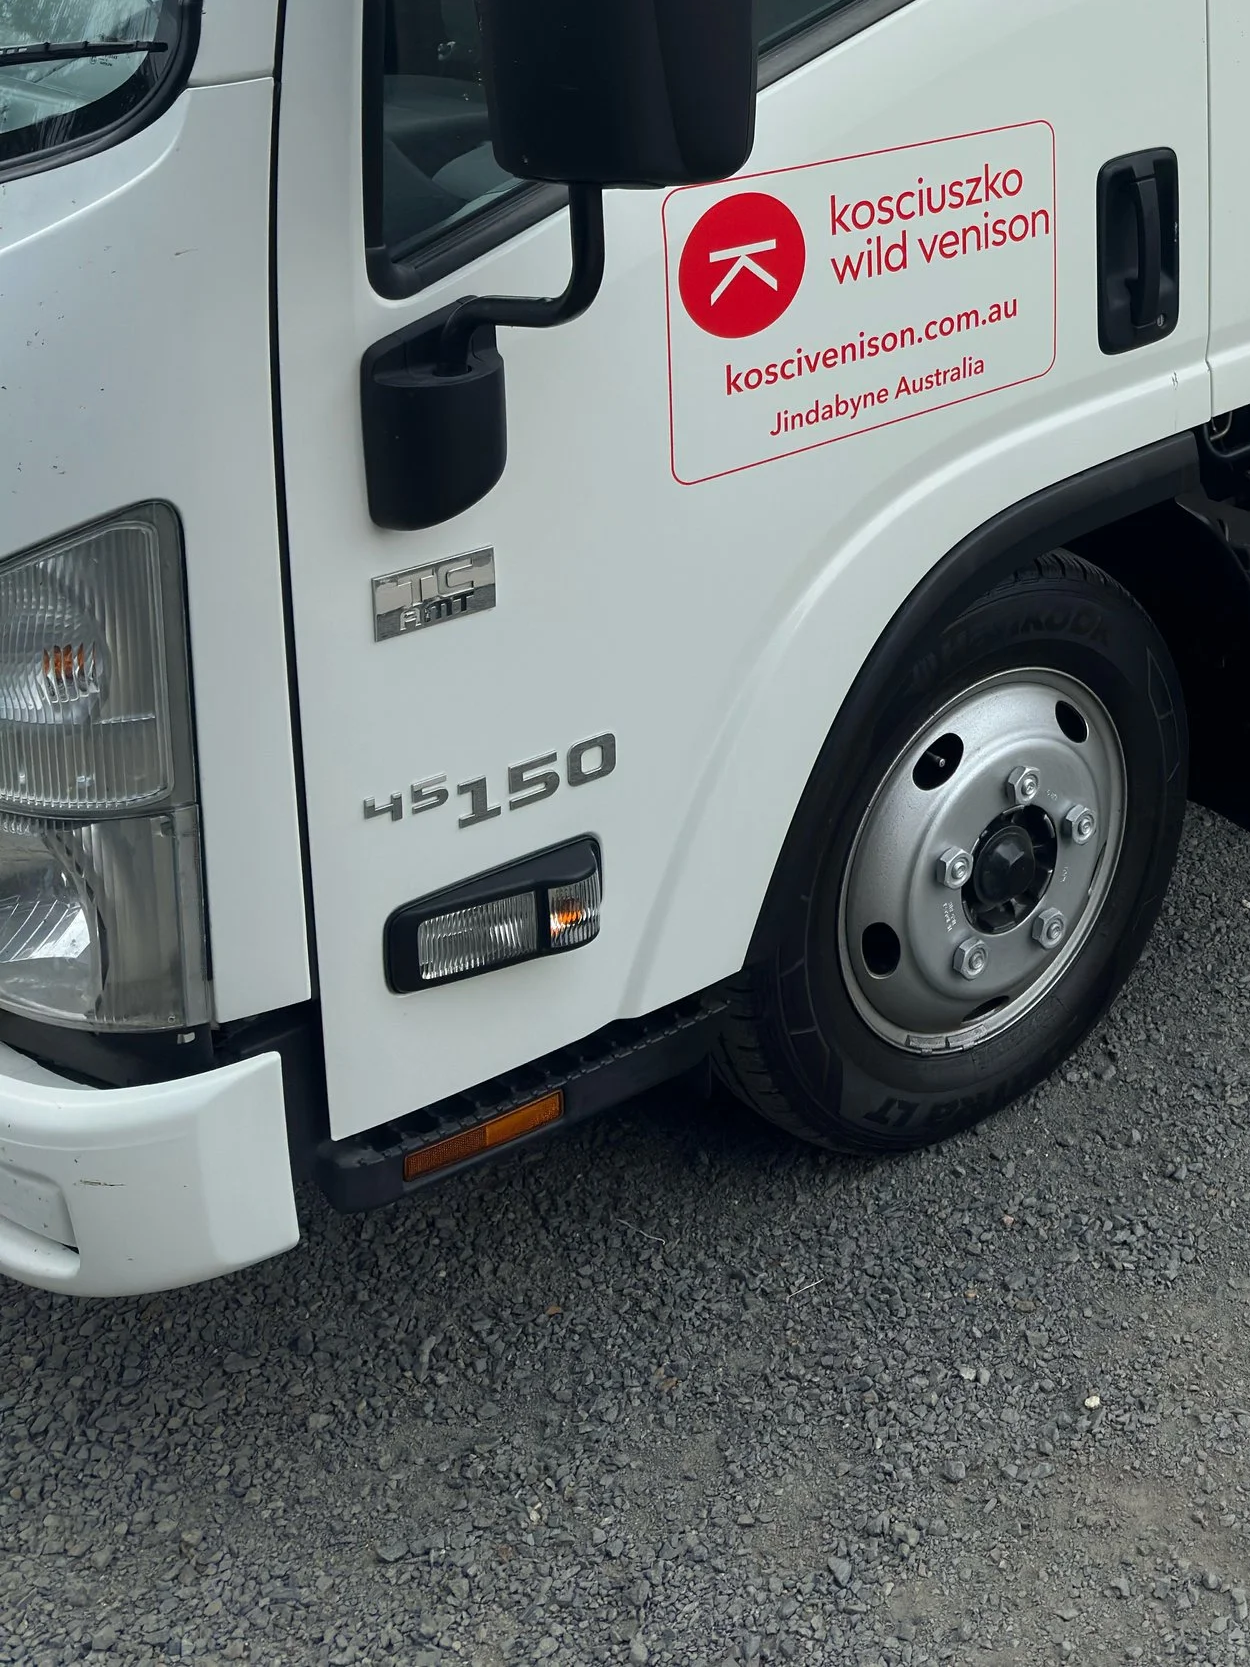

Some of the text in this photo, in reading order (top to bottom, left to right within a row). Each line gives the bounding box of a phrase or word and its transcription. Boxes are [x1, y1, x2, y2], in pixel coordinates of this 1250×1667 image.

[830, 163, 1024, 236] kosciuszko
[830, 208, 1051, 285] wild venison
[725, 297, 1018, 396] koscivenison.com.au
[769, 356, 986, 436] Jindabyne Australia
[399, 594, 475, 632] AMT
